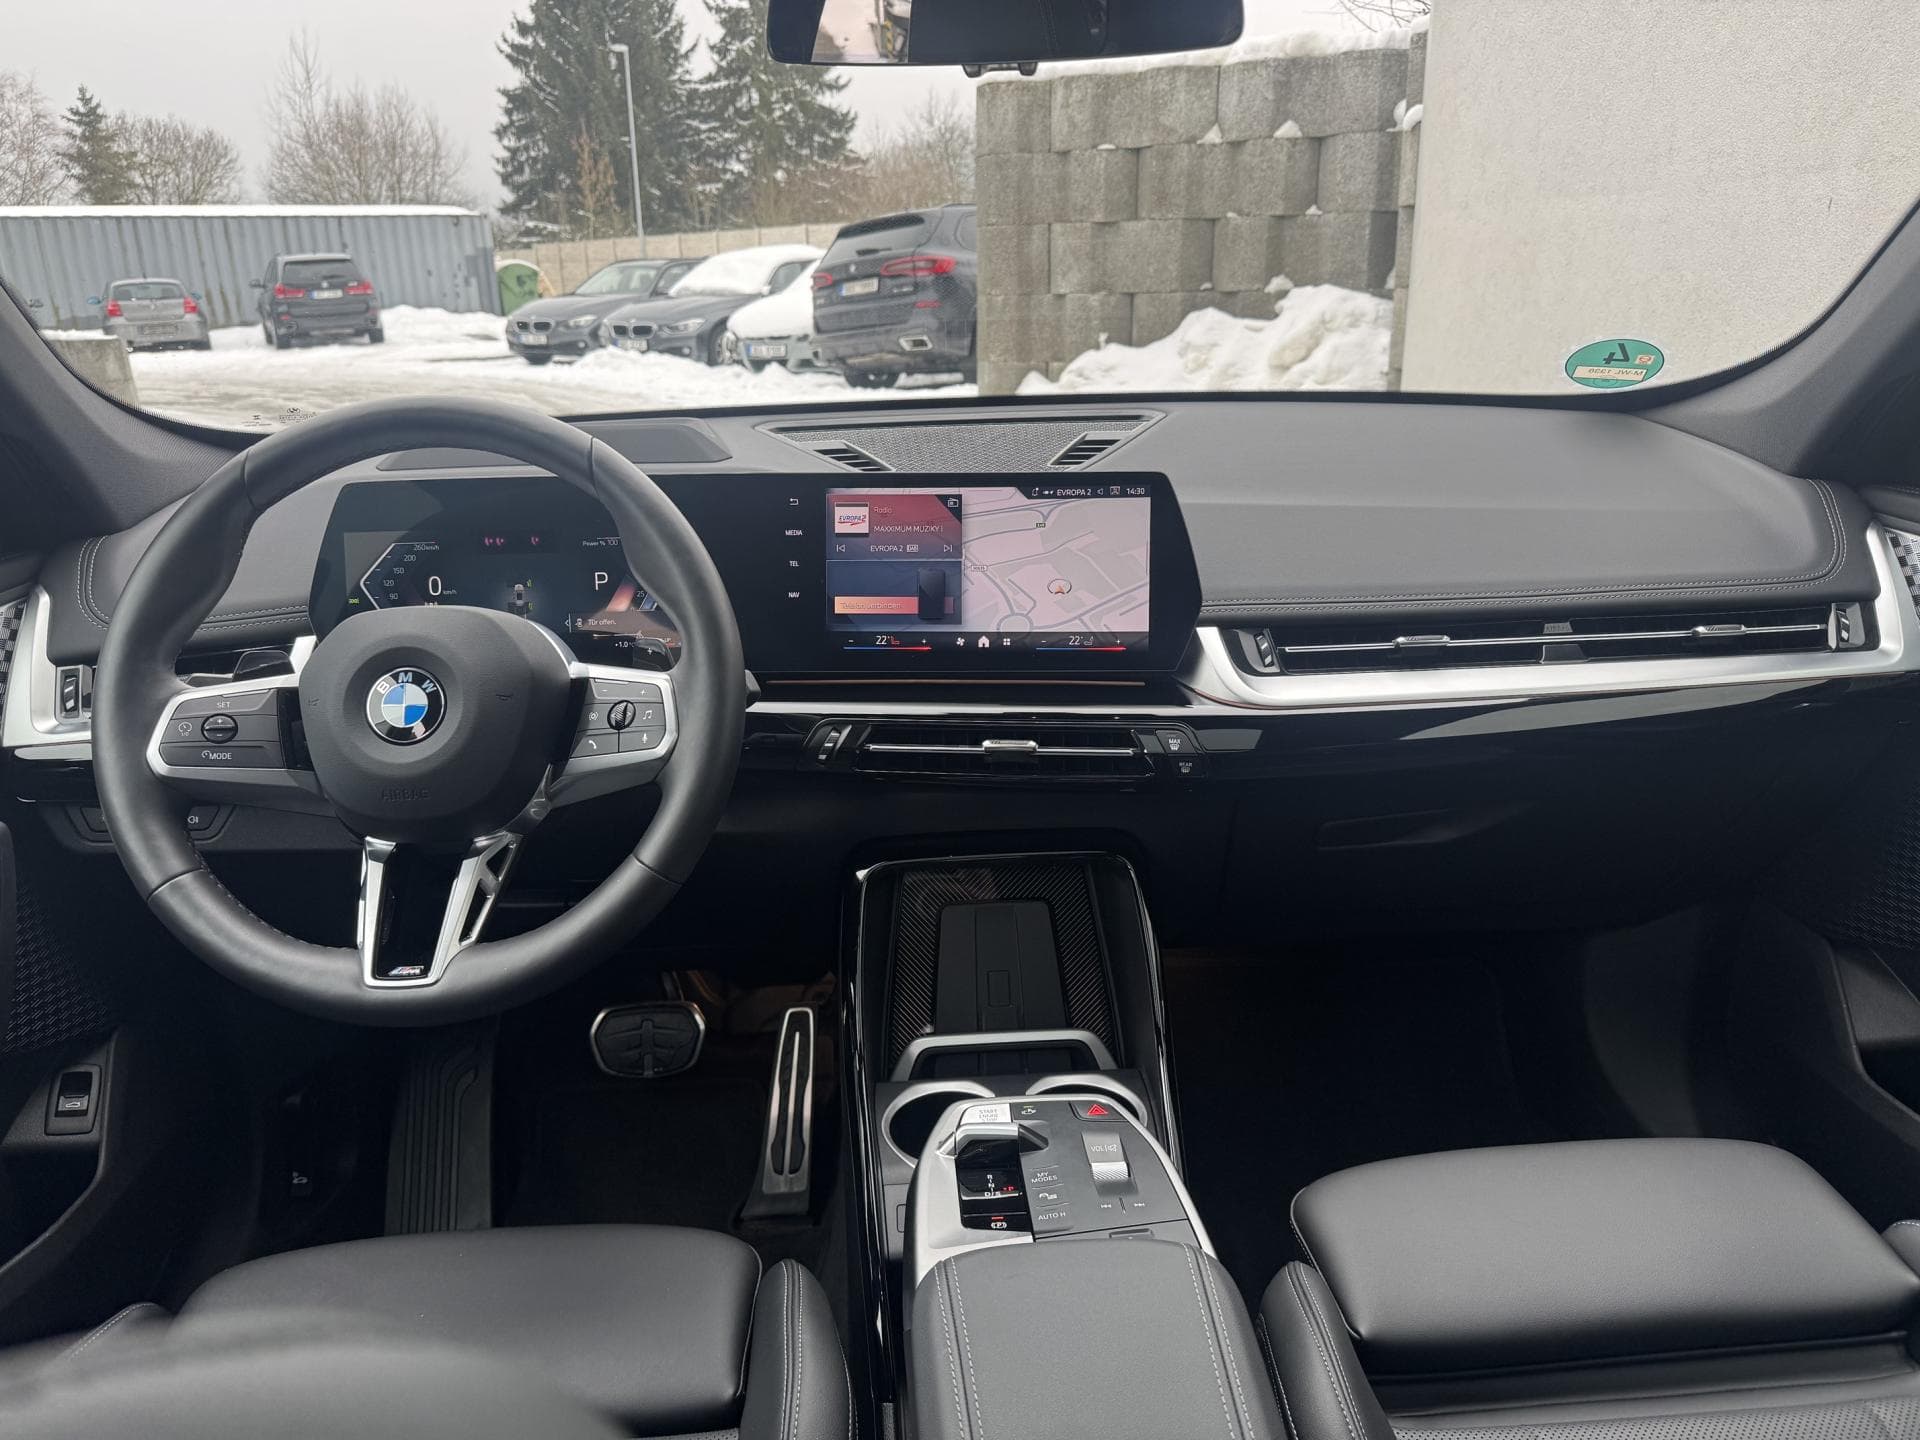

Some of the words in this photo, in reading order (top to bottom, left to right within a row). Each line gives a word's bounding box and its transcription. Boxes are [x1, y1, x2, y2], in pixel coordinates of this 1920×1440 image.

[1056, 489, 1086, 497] EVROPA
[1087, 488, 1092, 496] 2
[1126, 487, 1146, 496] 14:30
[874, 506, 893, 514] Radio
[873, 525, 912, 533] MAXXIMUM
[913, 525, 940, 533] MUZIKY
[404, 554, 417, 562] 200
[393, 567, 405, 575] 150
[383, 579, 395, 587] 120
[594, 571, 609, 591] P
[428, 576, 442, 596] 0
[636, 590, 645, 598] 25
[376, 672, 437, 695] BMW
[216, 701, 231, 709] SET
[209, 752, 233, 760] MODE
[1089, 1143, 1105, 1152] VOL
[1031, 1174, 1058, 1184] MODES
[1038, 1212, 1059, 1220] AUTO
